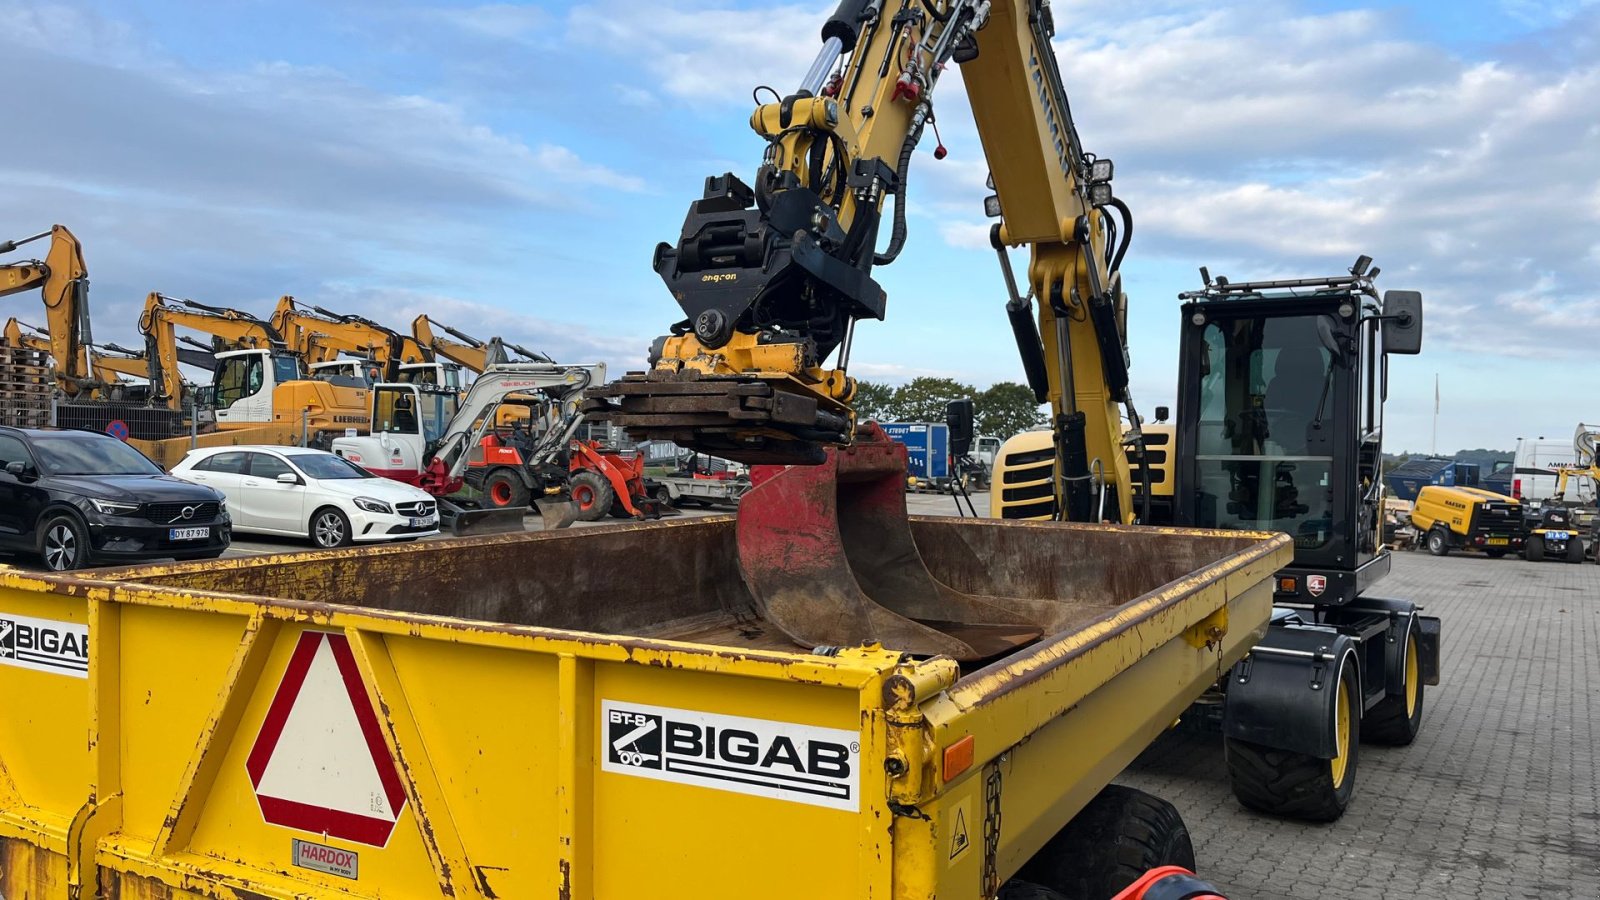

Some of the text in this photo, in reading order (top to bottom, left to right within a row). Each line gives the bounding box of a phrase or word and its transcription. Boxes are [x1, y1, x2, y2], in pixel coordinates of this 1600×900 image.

[1028, 42, 1069, 180] YANMAR
[175, 529, 209, 538] DY 87 978
[610, 711, 647, 727] BT-8
[301, 844, 353, 868] HARDOX
